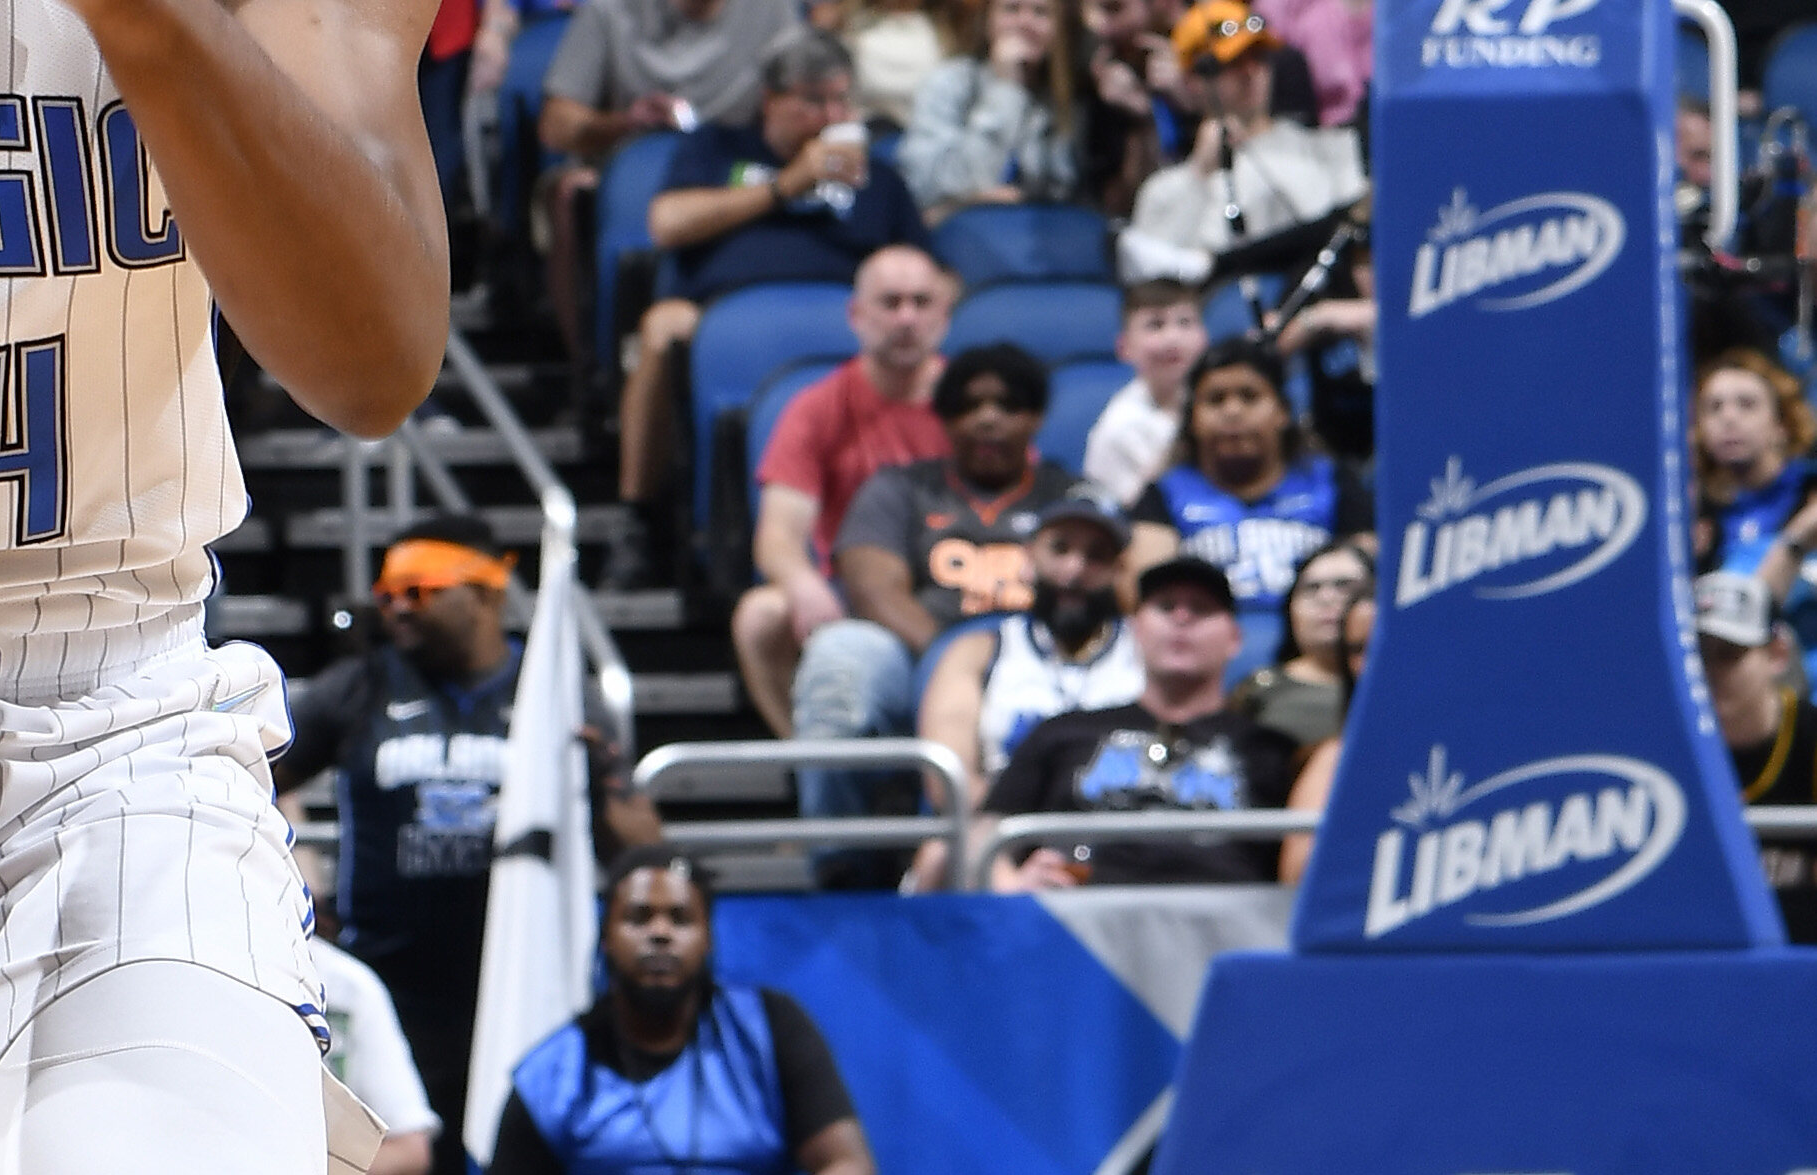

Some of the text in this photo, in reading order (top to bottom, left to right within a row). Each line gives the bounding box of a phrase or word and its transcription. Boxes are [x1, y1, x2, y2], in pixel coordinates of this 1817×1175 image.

[1421, 35, 1601, 68] FUNDING
[1407, 213, 1601, 319] LIBMAN
[1394, 488, 1617, 609] LIBMAN
[1363, 786, 1650, 938] LIBMAN
